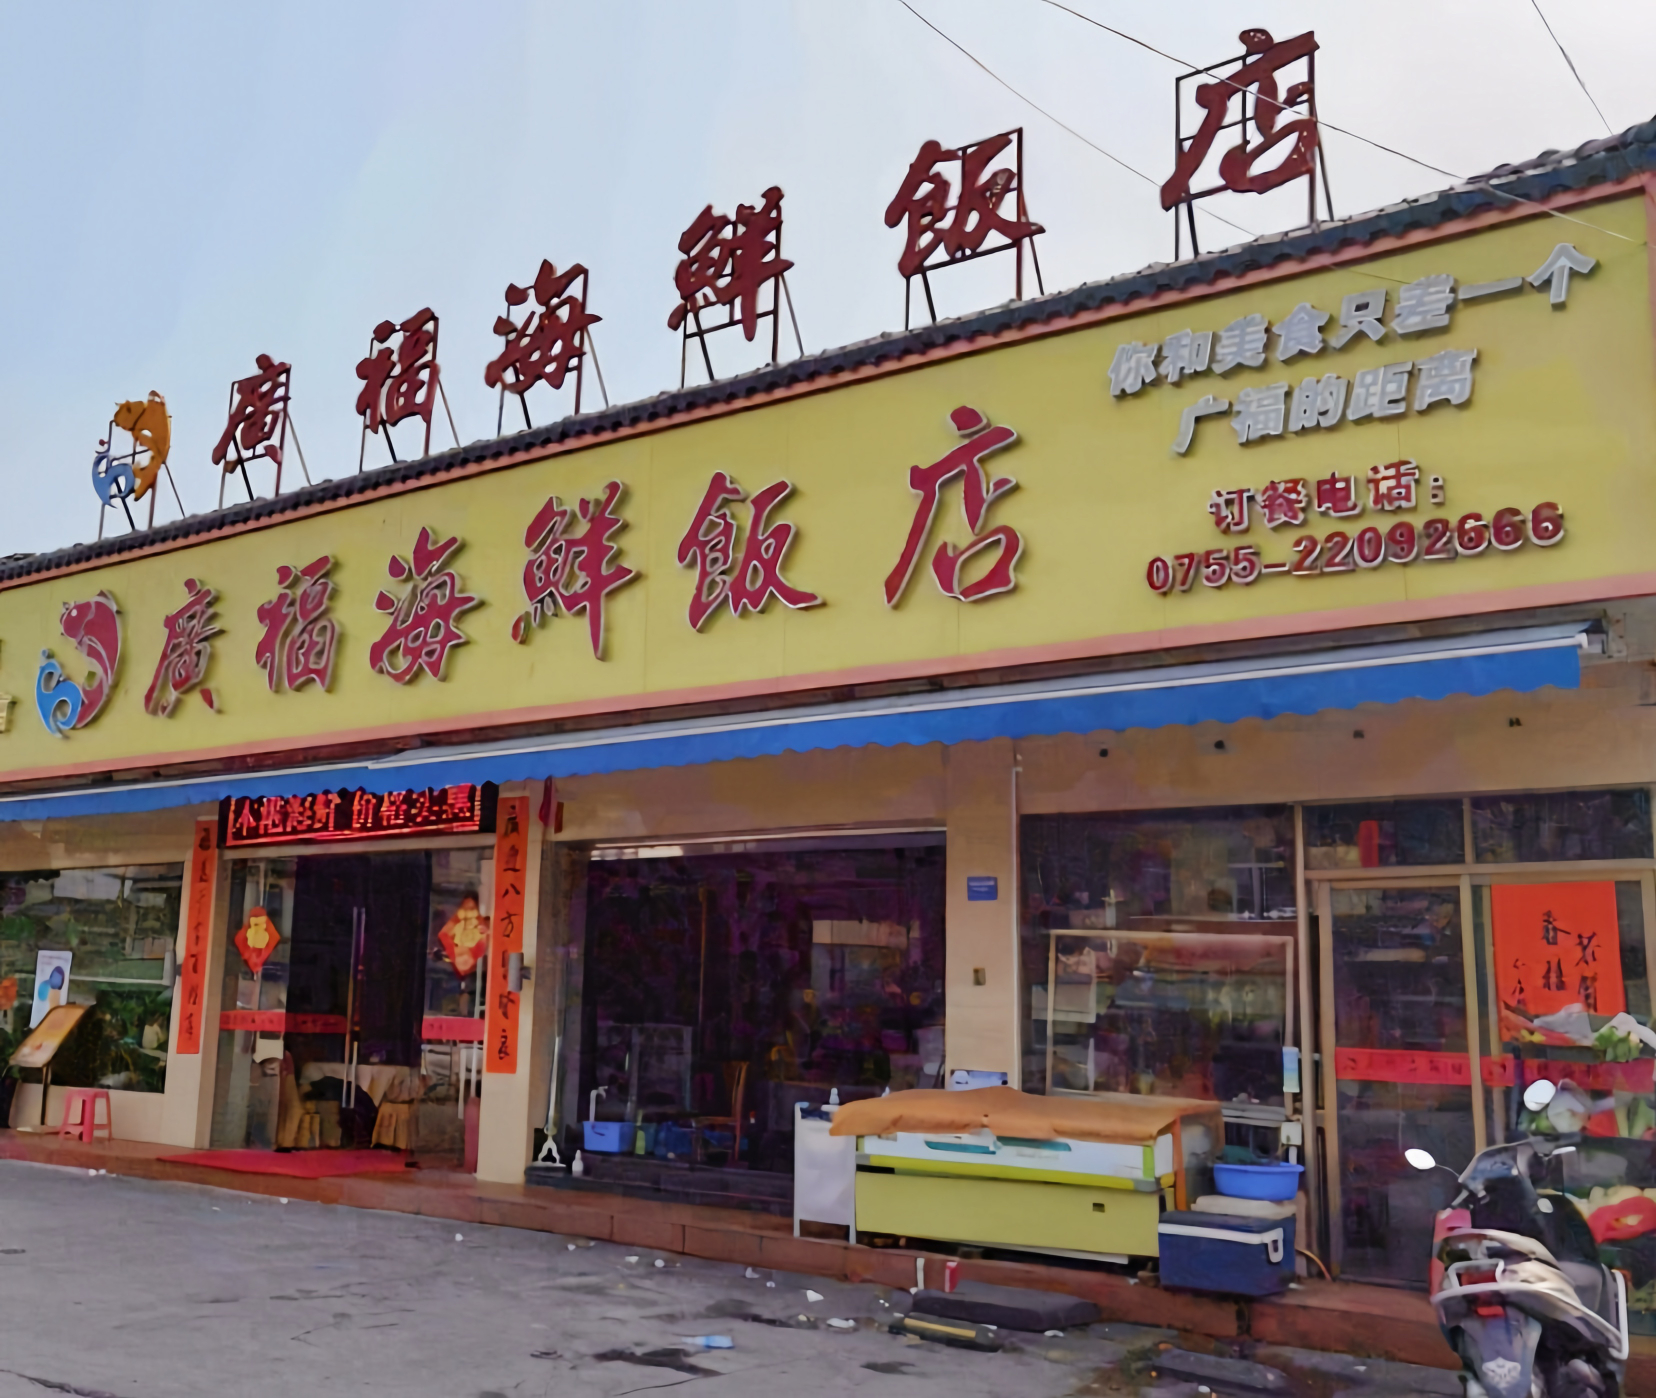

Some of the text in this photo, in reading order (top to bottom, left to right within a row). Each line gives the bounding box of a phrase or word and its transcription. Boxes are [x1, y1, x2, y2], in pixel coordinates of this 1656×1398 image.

[1107, 242, 1598, 397] 你和美食只差一个
[1172, 349, 1478, 455] 广福的距离
[1146, 501, 1566, 595] 0755-22092666
